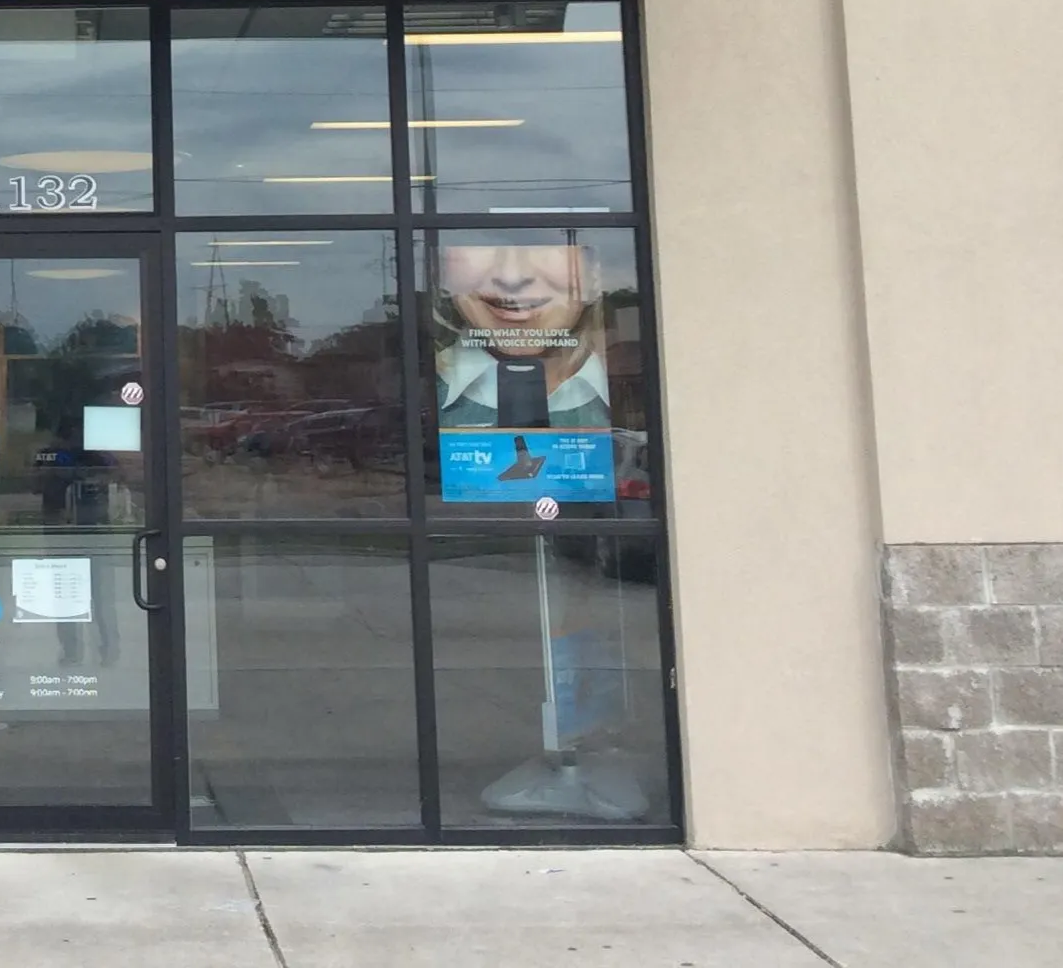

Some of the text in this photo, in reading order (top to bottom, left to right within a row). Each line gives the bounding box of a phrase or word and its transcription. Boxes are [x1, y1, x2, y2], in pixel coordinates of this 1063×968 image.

[469, 328, 570, 337] FIND WHAT YOU LOVE
[461, 338, 578, 348] WITH A VOICE COMMAND
